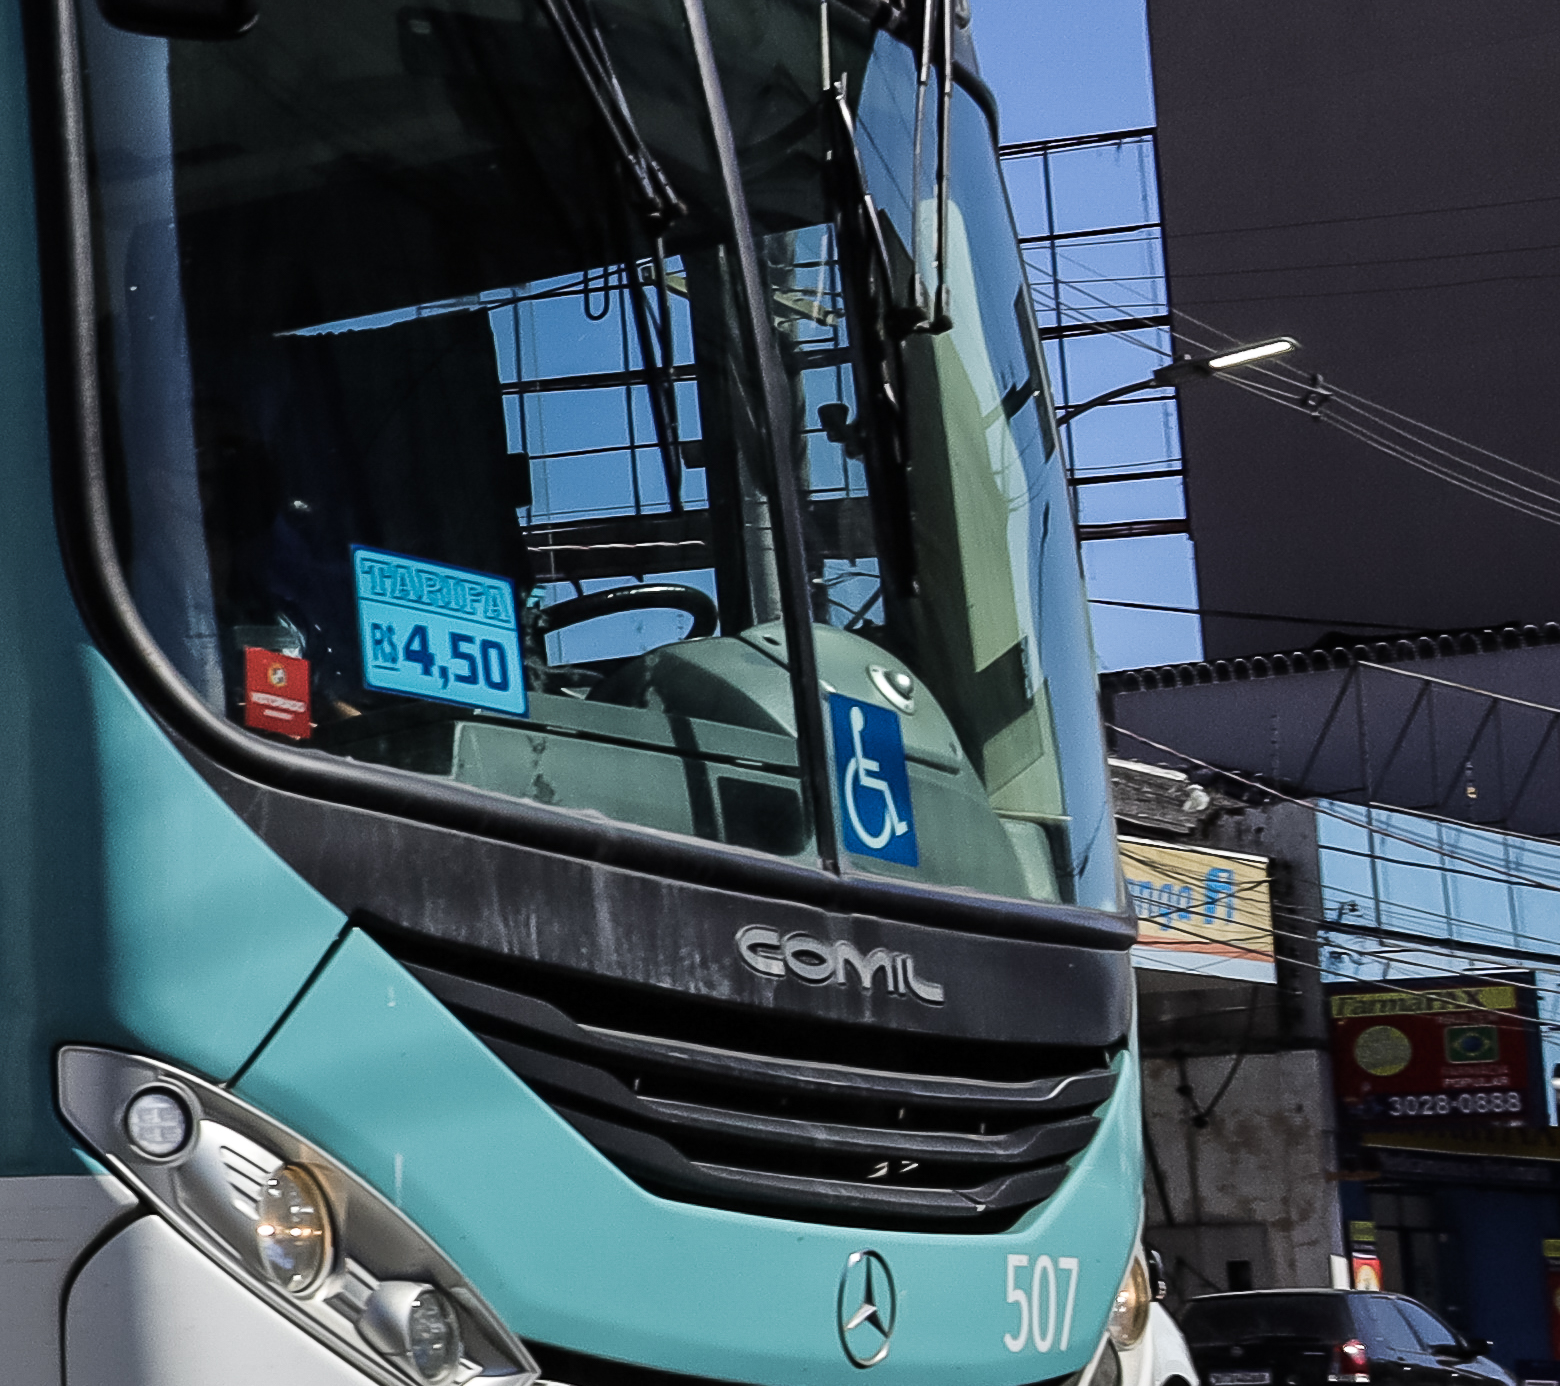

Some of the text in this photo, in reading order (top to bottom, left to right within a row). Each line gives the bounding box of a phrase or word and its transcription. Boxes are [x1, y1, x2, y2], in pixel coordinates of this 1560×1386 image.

[360, 557, 512, 624] TARIFA
[734, 925, 945, 1007] COMIL
[1387, 1091, 1522, 1117] 3028-0888
[1003, 1253, 1080, 1353] 507
